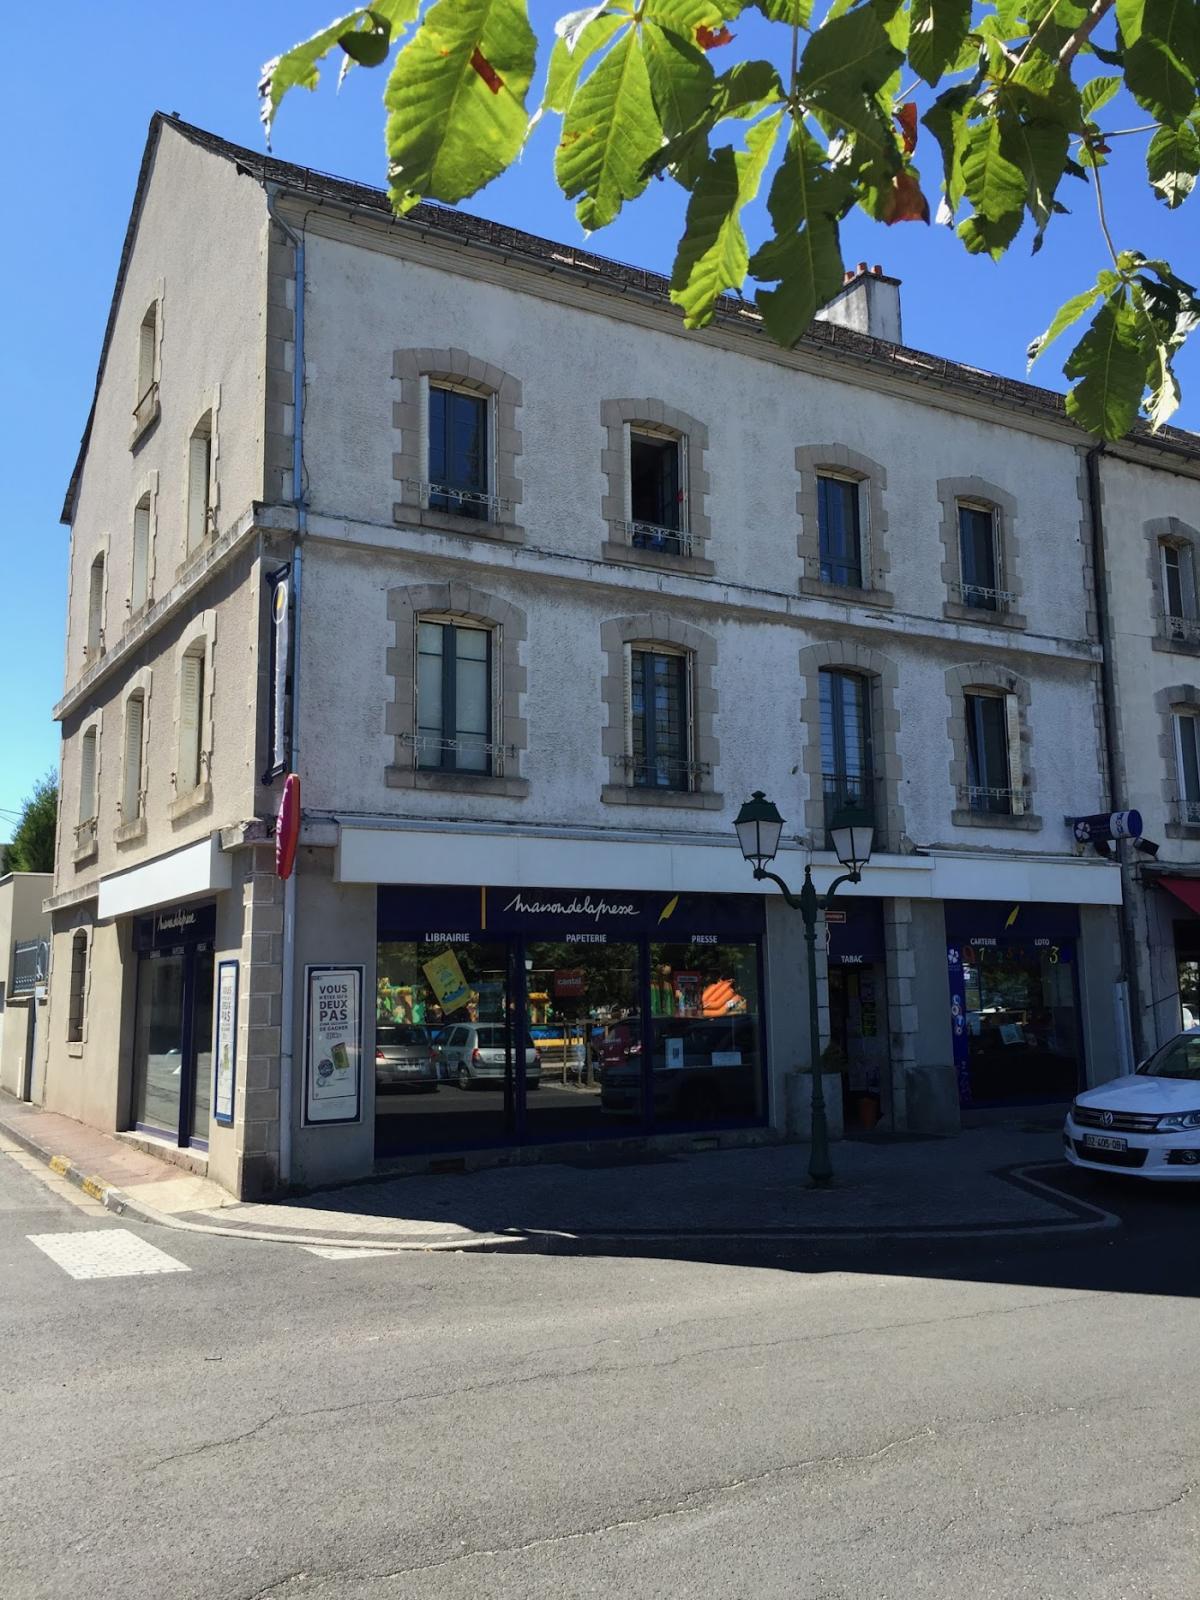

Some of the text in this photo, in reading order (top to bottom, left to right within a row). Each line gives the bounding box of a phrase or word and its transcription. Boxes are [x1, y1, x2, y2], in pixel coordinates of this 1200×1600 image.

[425, 932, 471, 943] LIBRAIRIE
[566, 933, 607, 944] PAPETERIE
[691, 935, 718, 944] PRESSE
[970, 938, 997, 946] CARTERIE
[1034, 938, 1050, 946] LOTO
[840, 955, 864, 964] TABAC
[319, 984, 348, 994] VOUS
[319, 1000, 348, 1010] DEUX
[319, 1009, 348, 1022] PAS
